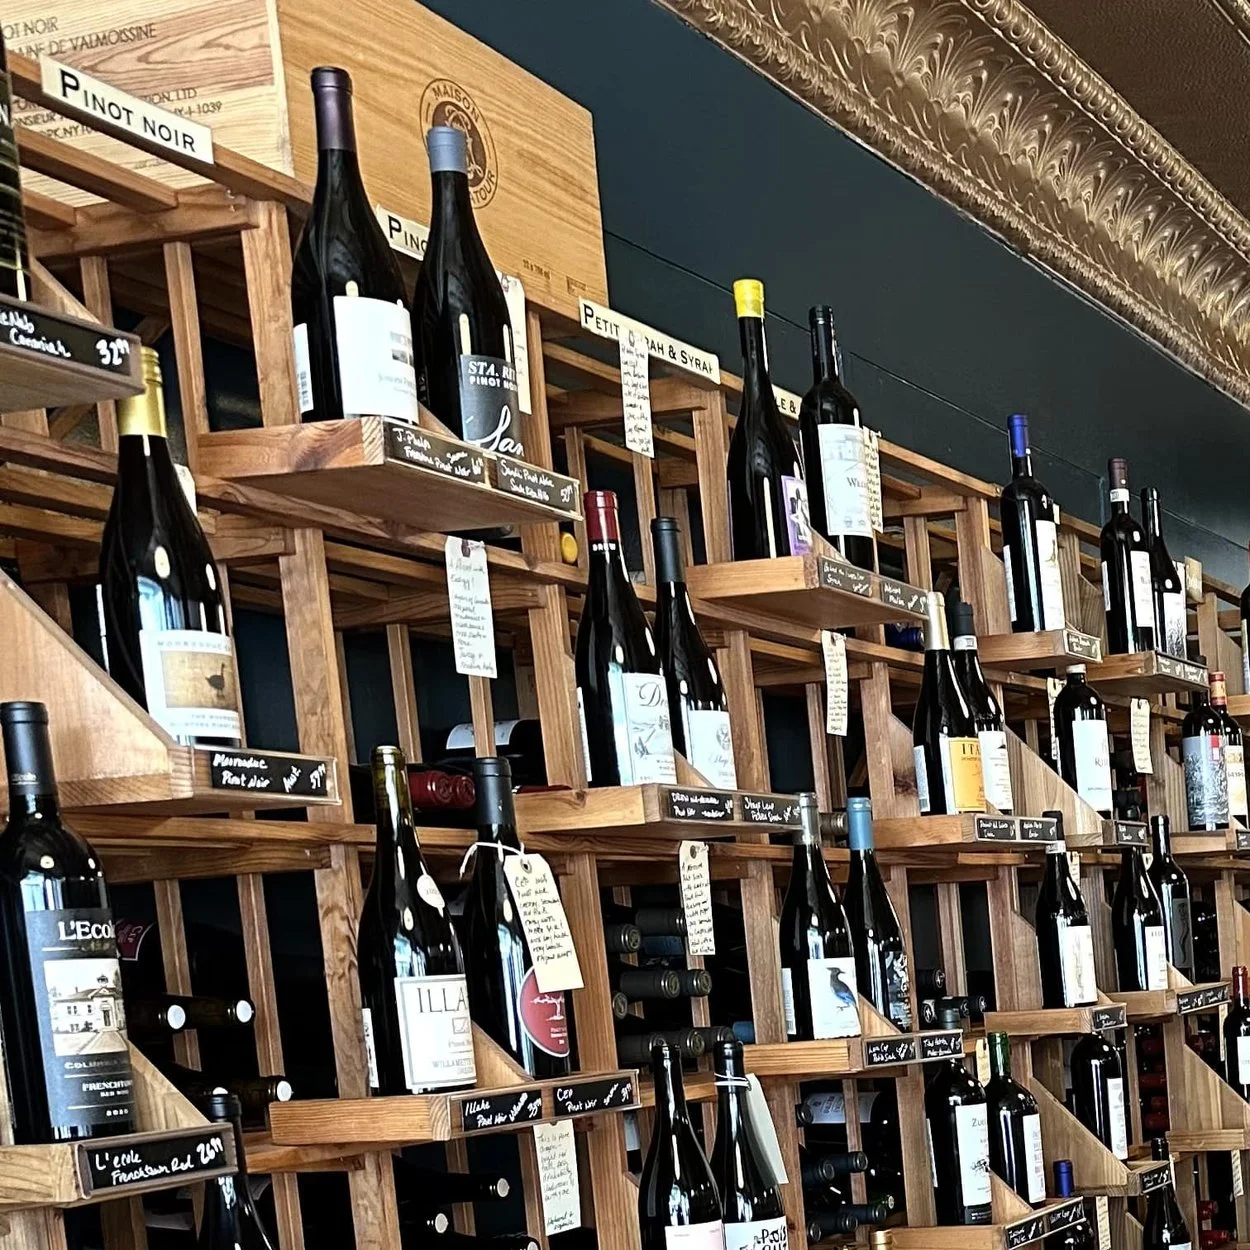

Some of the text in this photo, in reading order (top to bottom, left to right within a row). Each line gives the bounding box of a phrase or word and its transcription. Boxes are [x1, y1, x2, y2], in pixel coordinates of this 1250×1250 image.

[60, 69, 196, 152] PINOT NOIR
[432, 84, 480, 123] MAISON
[668, 344, 677, 360] &
[468, 361, 500, 377] STA.
[469, 376, 501, 388] PINOT
[592, 543, 616, 552] DREW
[416, 987, 468, 1014] ILLA
